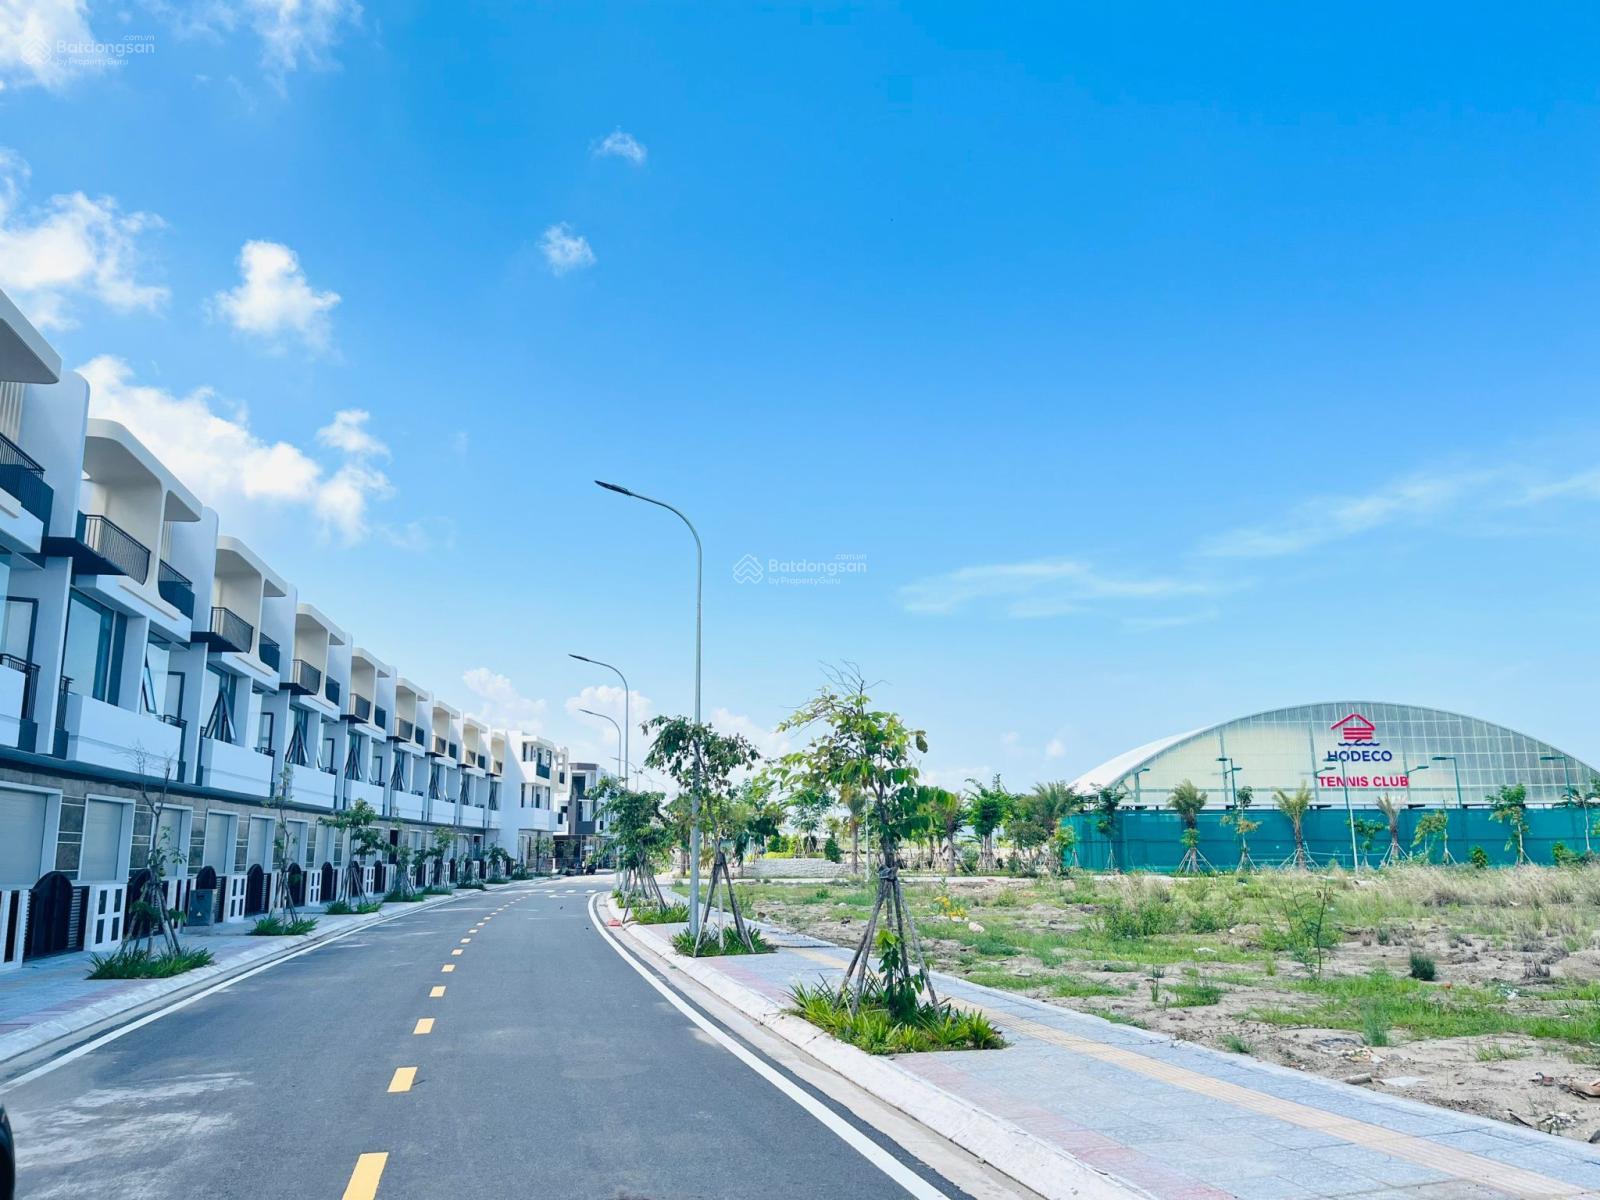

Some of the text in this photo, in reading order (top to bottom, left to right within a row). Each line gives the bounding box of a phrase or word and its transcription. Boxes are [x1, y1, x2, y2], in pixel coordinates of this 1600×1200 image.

[1327, 750, 1393, 762] HODECO
[1320, 776, 1409, 787] TENNIS CLUB
